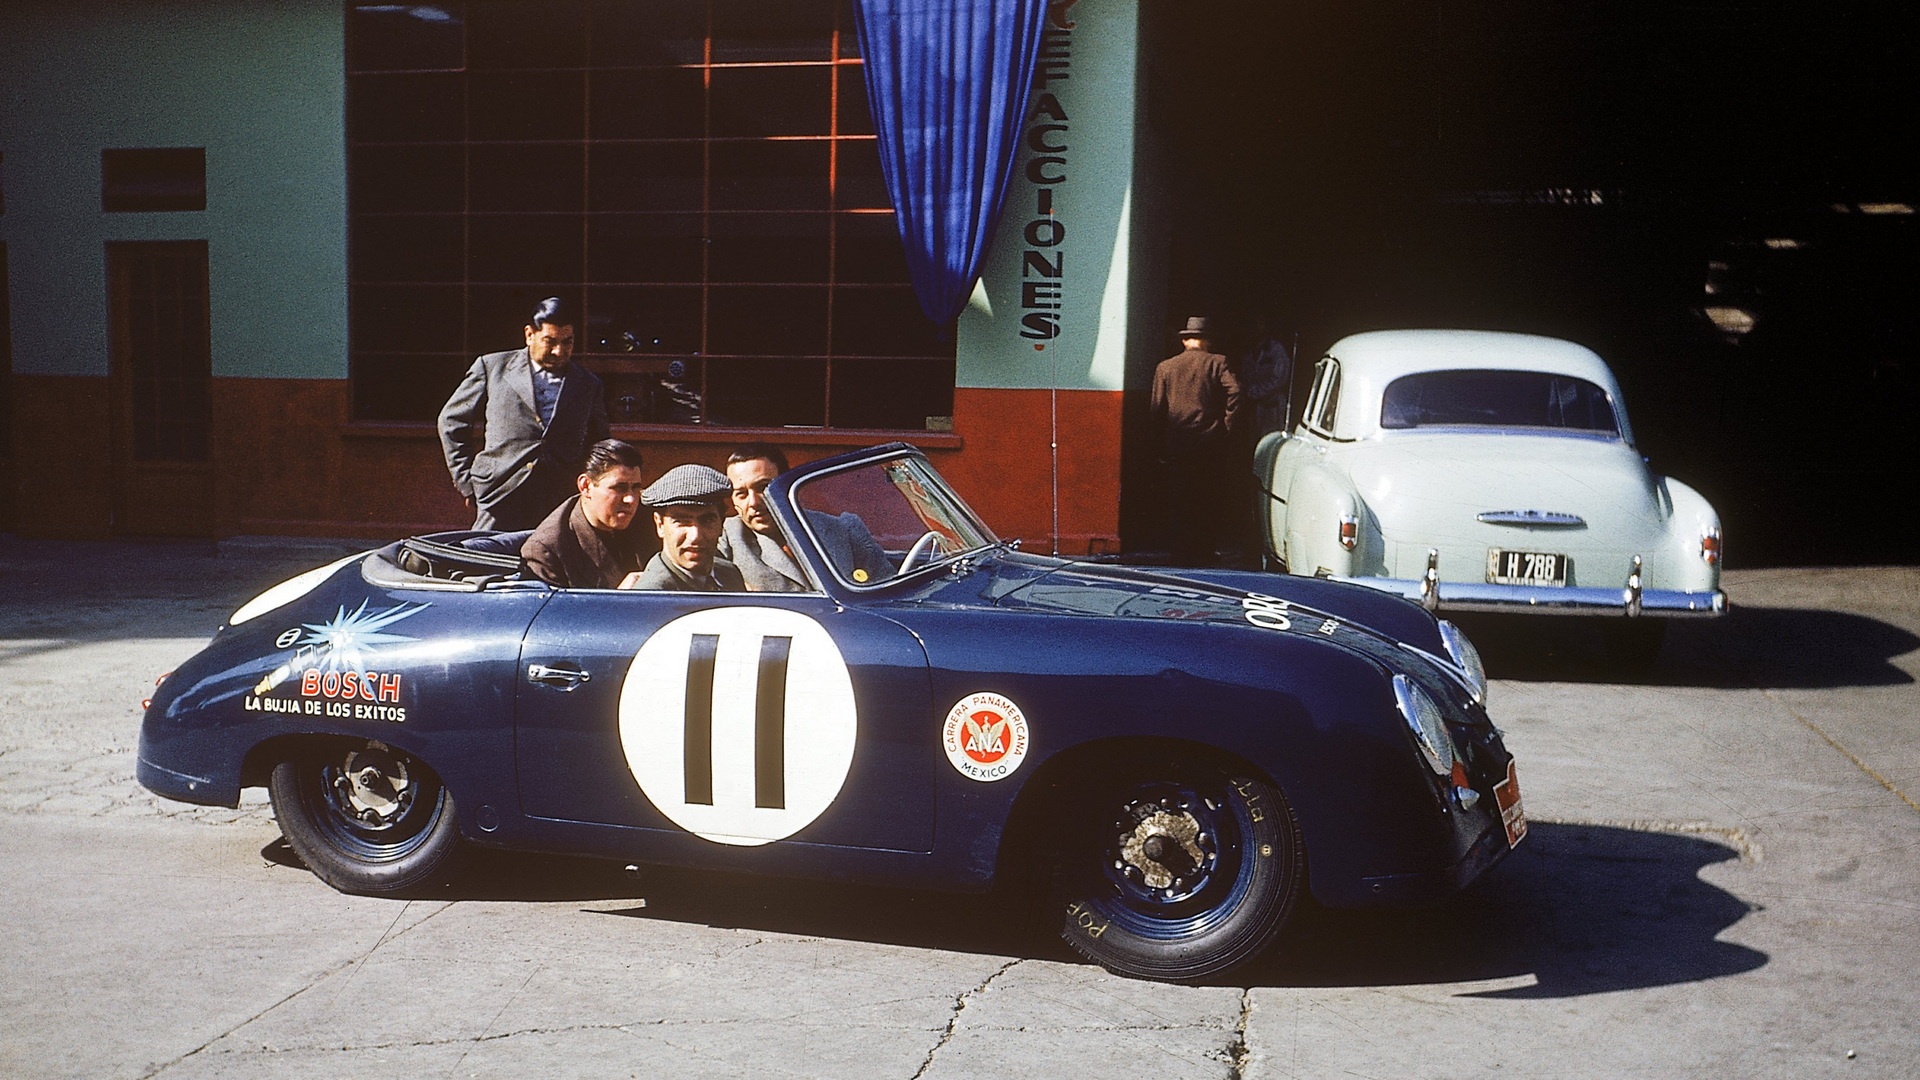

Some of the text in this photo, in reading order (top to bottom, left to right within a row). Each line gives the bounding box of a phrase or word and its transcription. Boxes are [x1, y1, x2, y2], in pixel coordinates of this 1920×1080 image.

[1507, 553, 1519, 578] H
[1524, 554, 1556, 580] 788
[301, 669, 402, 703] BOSCH
[245, 696, 406, 722] LA BUJIA DE LOS EXITOS
[684, 634, 793, 809] 11
[947, 696, 1026, 756] CARRERA PANAMERICANA
[965, 732, 1005, 753] ANA
[961, 762, 1007, 778] MEXICO
